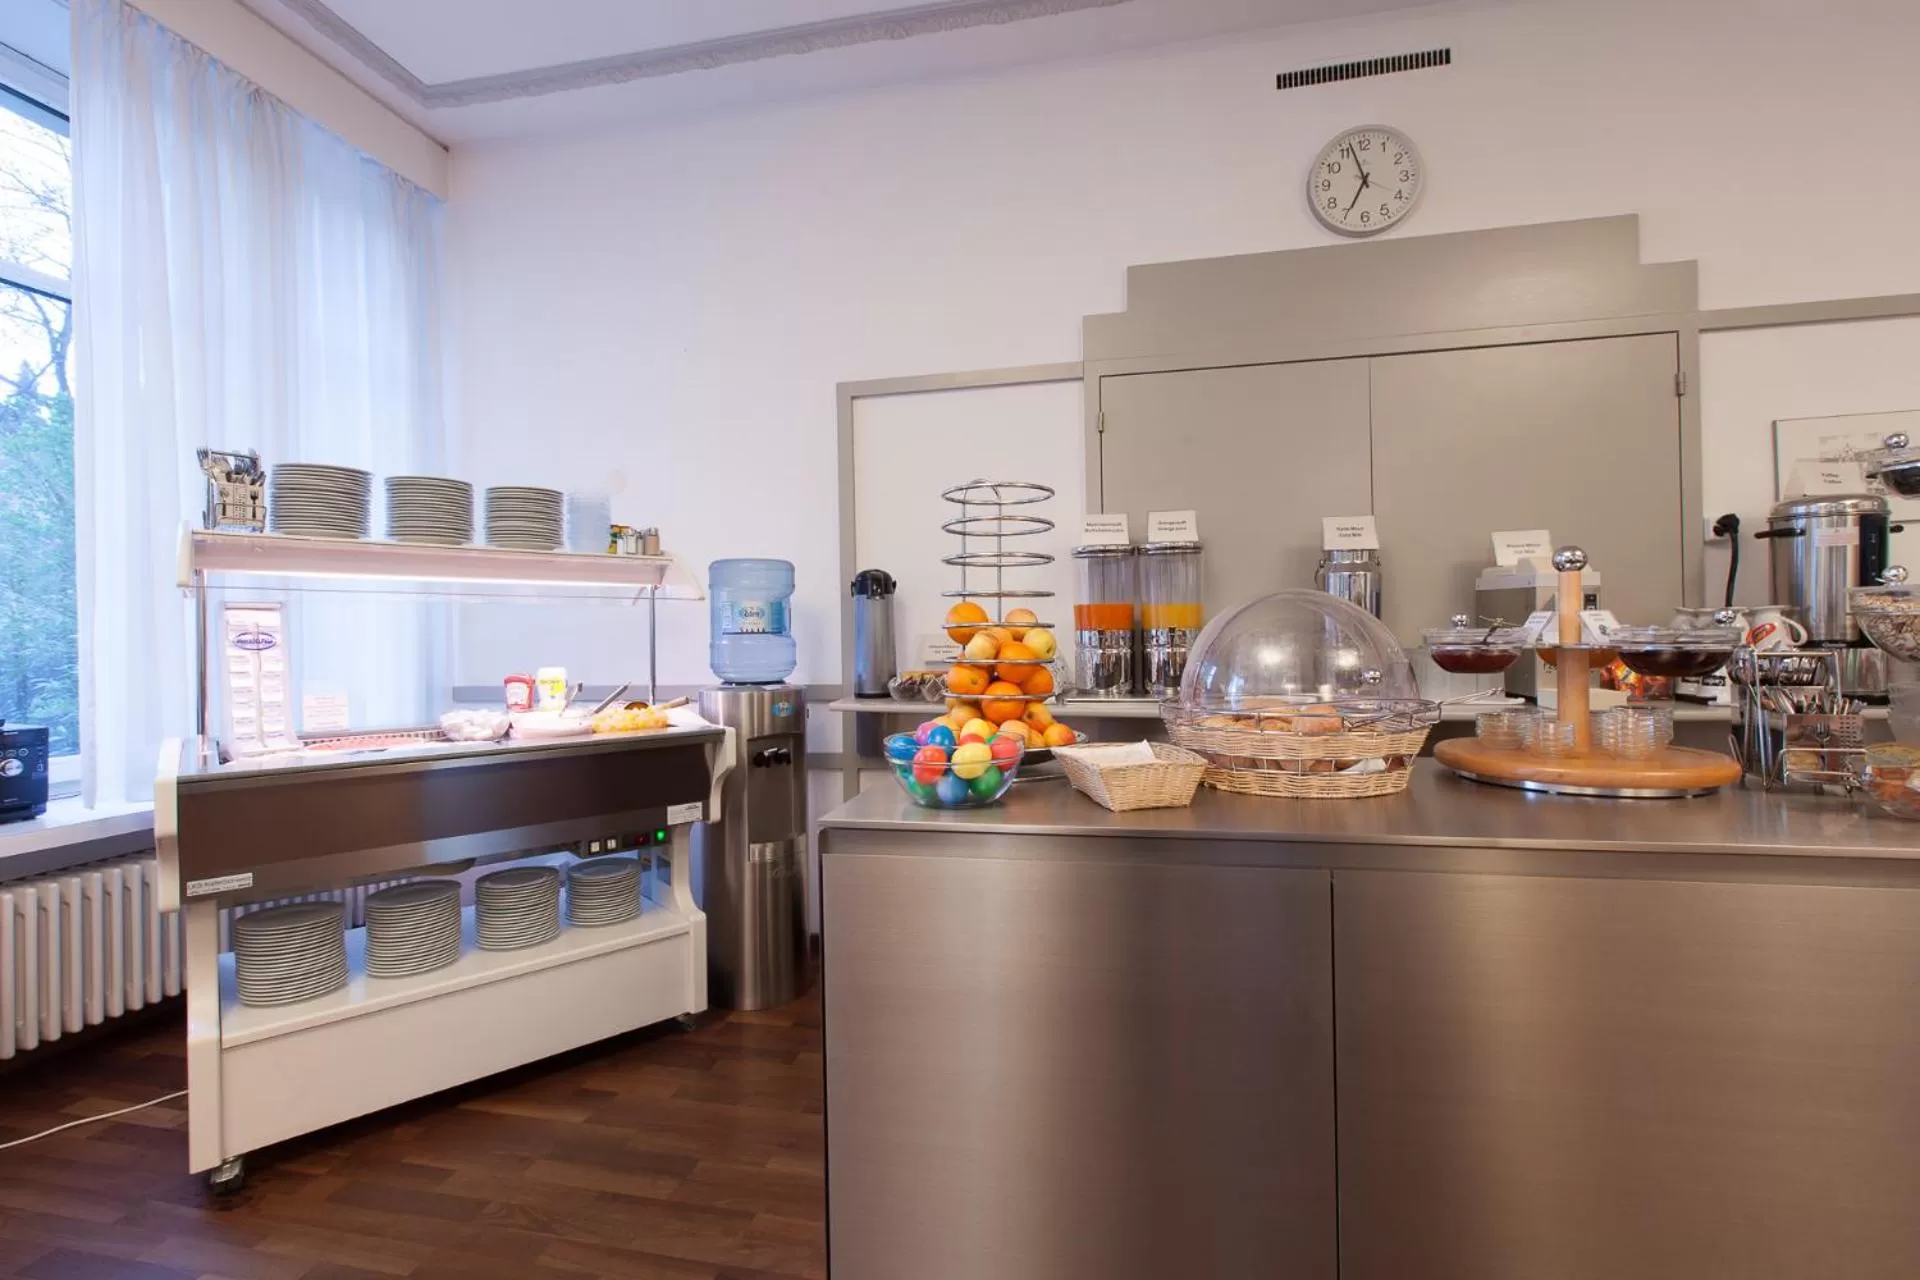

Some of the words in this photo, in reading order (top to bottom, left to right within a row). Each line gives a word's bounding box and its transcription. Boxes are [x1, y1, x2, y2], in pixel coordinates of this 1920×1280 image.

[1357, 138, 1371, 151] 12
[1380, 141, 1386, 153] 1
[1339, 147, 1350, 160] 11
[1393, 152, 1404, 165] 2
[1327, 161, 1341, 174] 10
[1399, 169, 1410, 182] 3
[1321, 179, 1331, 191] 9
[1393, 189, 1403, 201] 4
[1327, 197, 1337, 209] 8
[1379, 203, 1390, 216] 5
[1342, 208, 1351, 220] 7
[1360, 210, 1371, 223] 6
